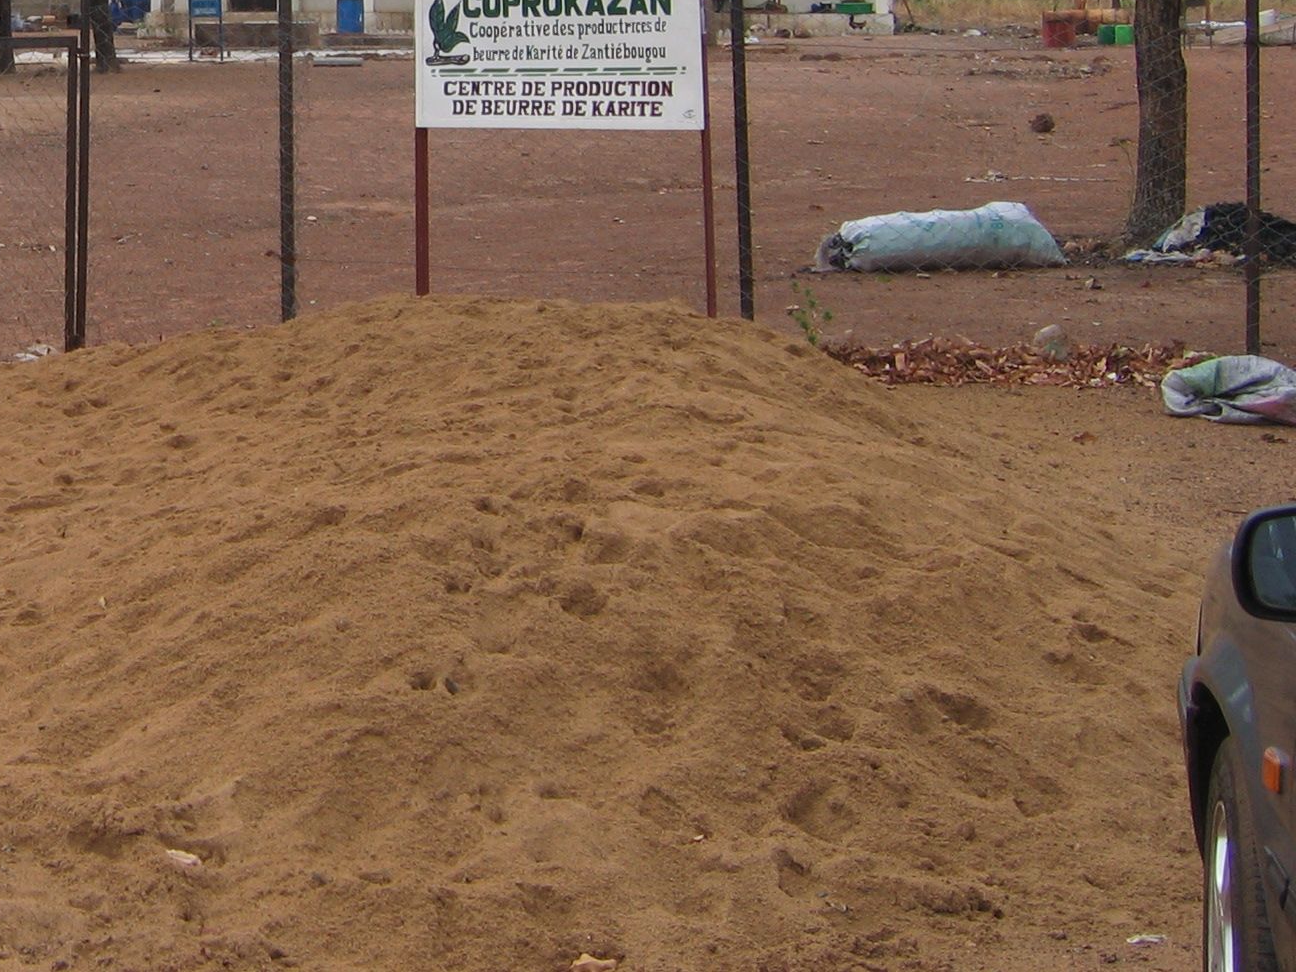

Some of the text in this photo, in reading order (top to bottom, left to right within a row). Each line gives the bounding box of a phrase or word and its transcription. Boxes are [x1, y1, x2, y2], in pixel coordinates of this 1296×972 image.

[469, 16, 667, 43] Coopérative des productrices de
[472, 42, 666, 63] beurre de Karité de Zantiébougou
[443, 80, 674, 97] CENTRE DE PRODUCTION
[452, 99, 664, 117] DE BEURRE DE KARITE
